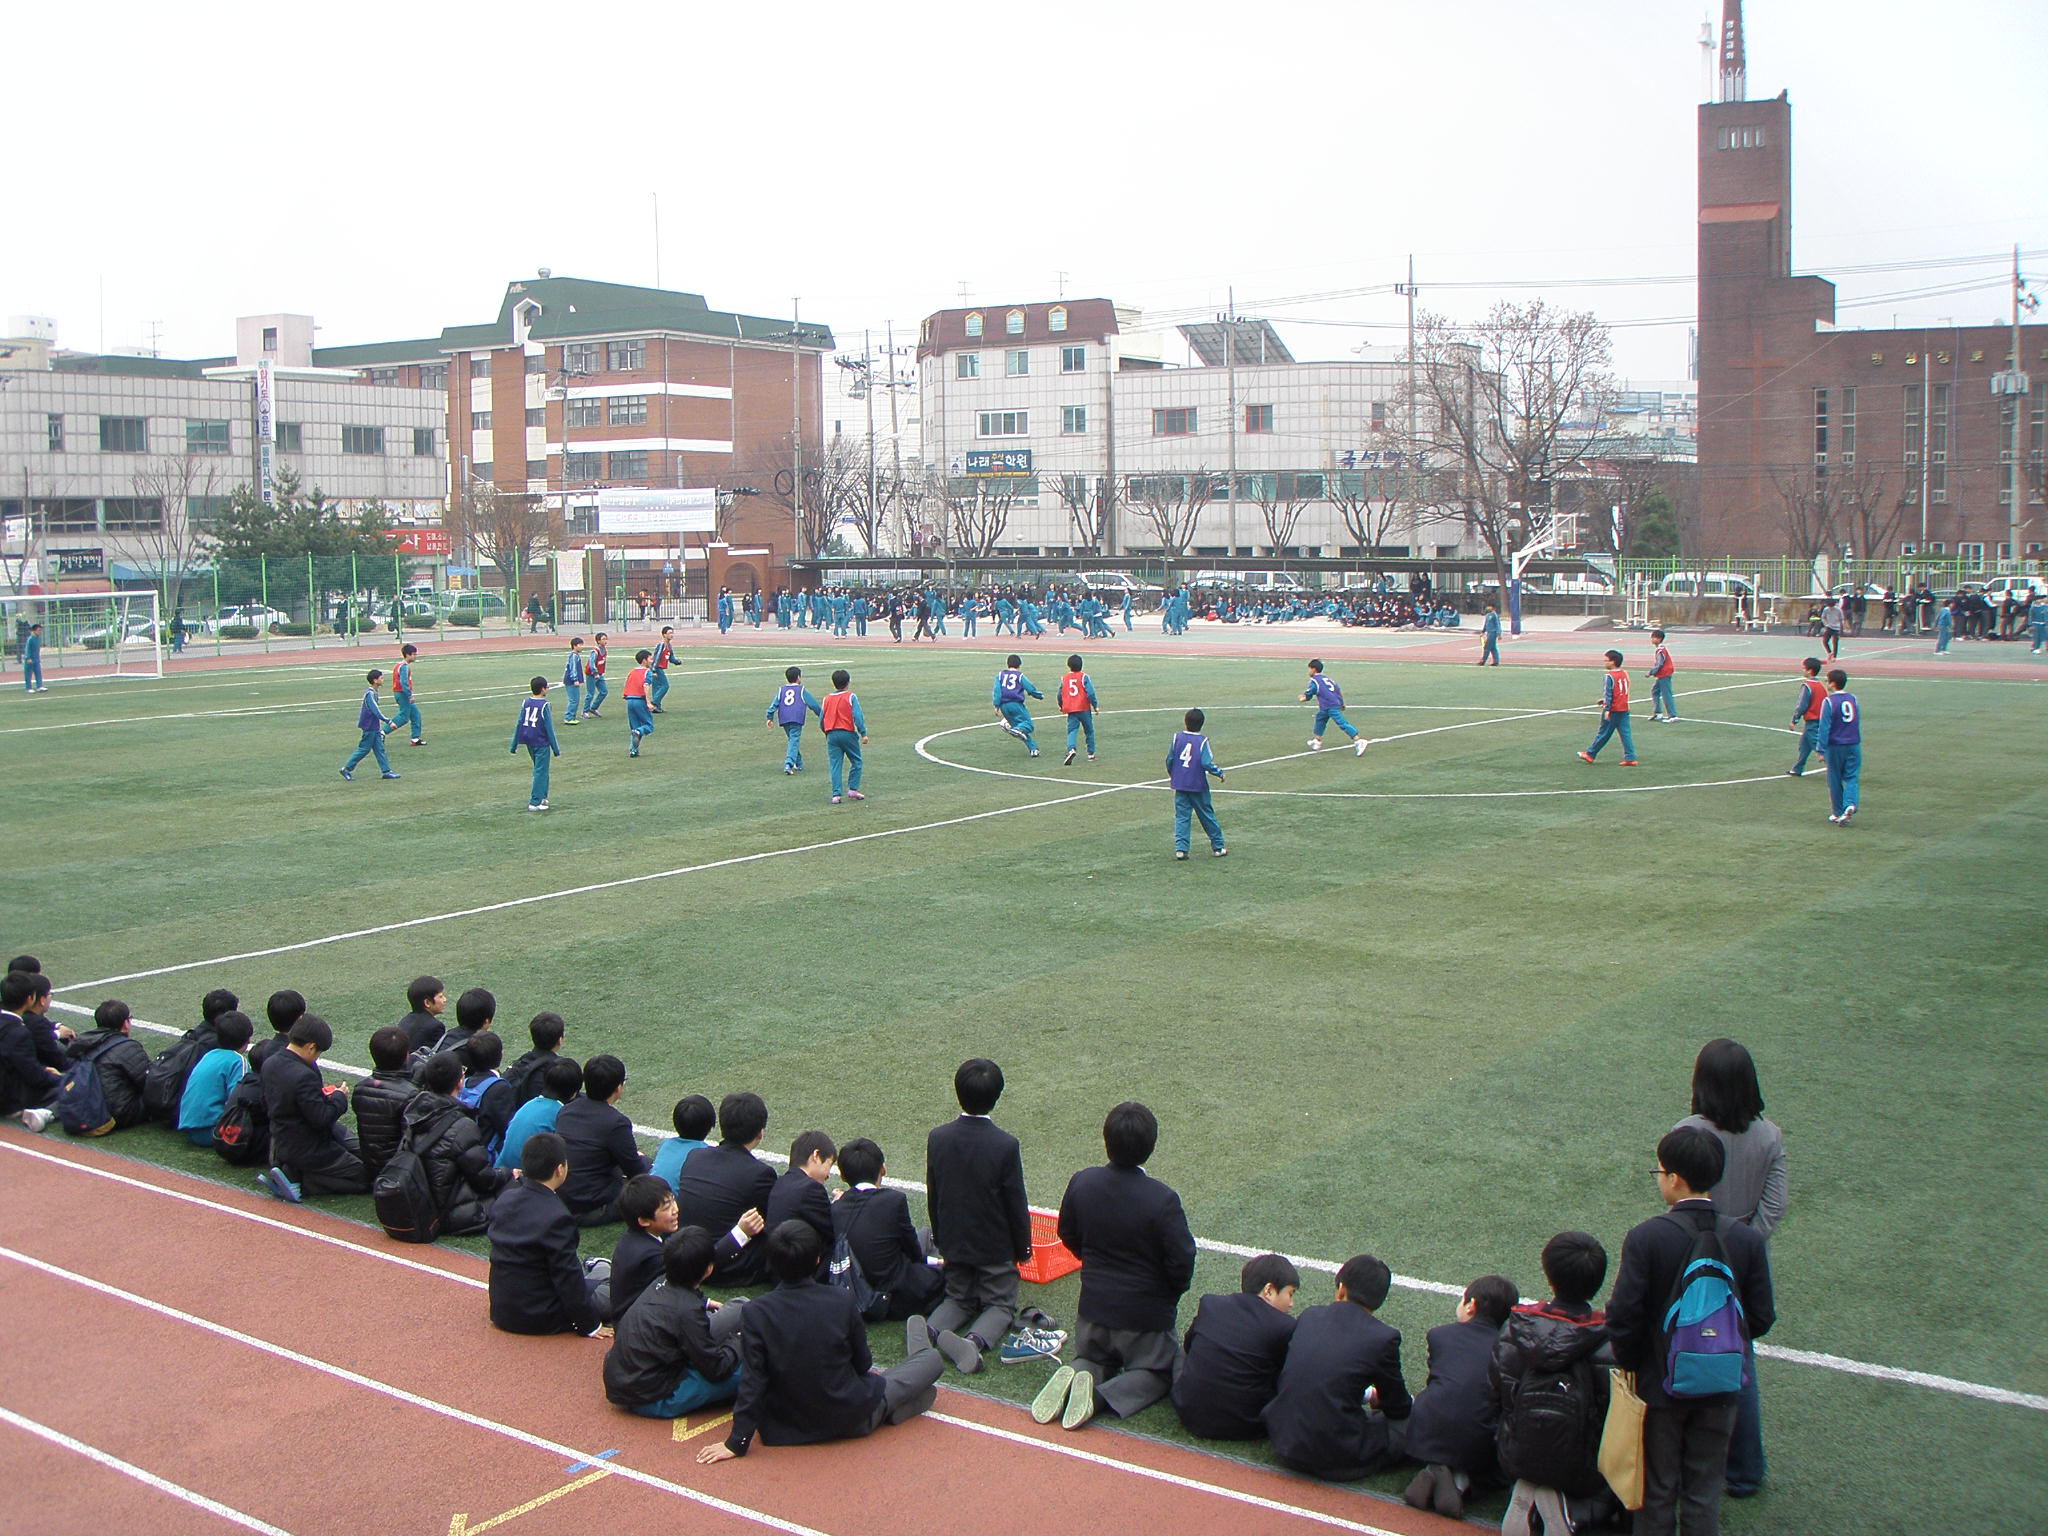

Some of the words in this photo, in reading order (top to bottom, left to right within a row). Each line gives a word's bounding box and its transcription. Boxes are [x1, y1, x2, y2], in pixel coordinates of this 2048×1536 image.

[968, 456, 990, 467] 나래
[1005, 454, 1028, 469] 학원
[1002, 673, 1017, 689] 13
[1069, 679, 1078, 697] 5
[1322, 677, 1335, 692] 5
[1618, 677, 1629, 696] 11
[783, 689, 795, 706] 8
[523, 706, 539, 727] 14
[1841, 701, 1854, 723] 9
[1179, 743, 1192, 768] 4
